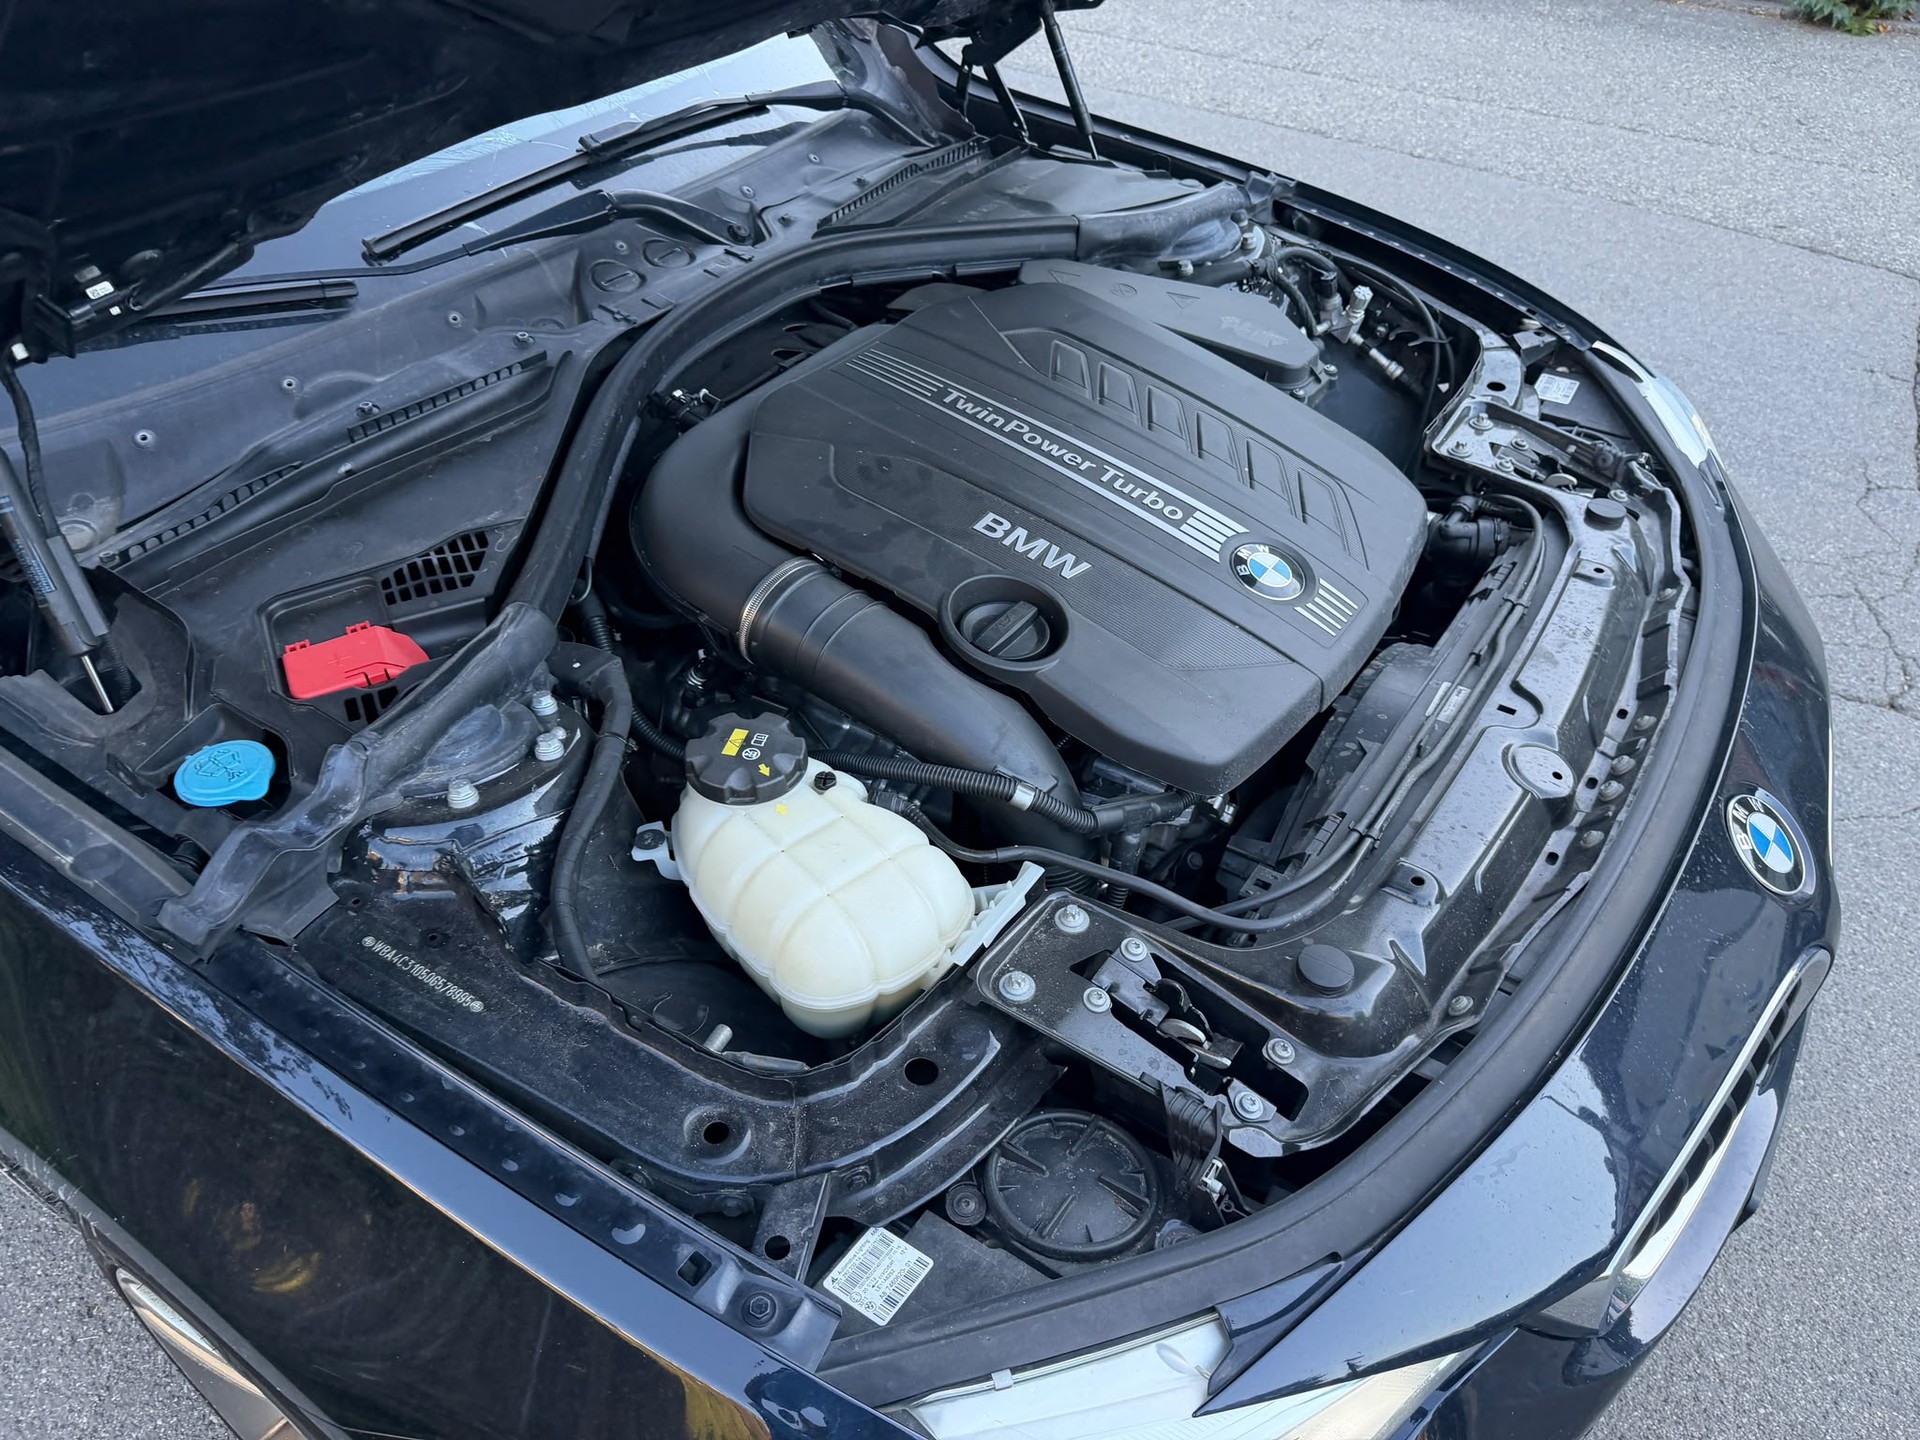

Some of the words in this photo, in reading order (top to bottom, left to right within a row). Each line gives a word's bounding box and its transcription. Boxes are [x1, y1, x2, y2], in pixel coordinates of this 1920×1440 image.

[942, 388, 1097, 472] TwinPower
[1100, 465, 1184, 521] Turbo
[973, 512, 1092, 580] BMW
[1236, 544, 1269, 576] BMW
[1732, 797, 1765, 850] BMW
